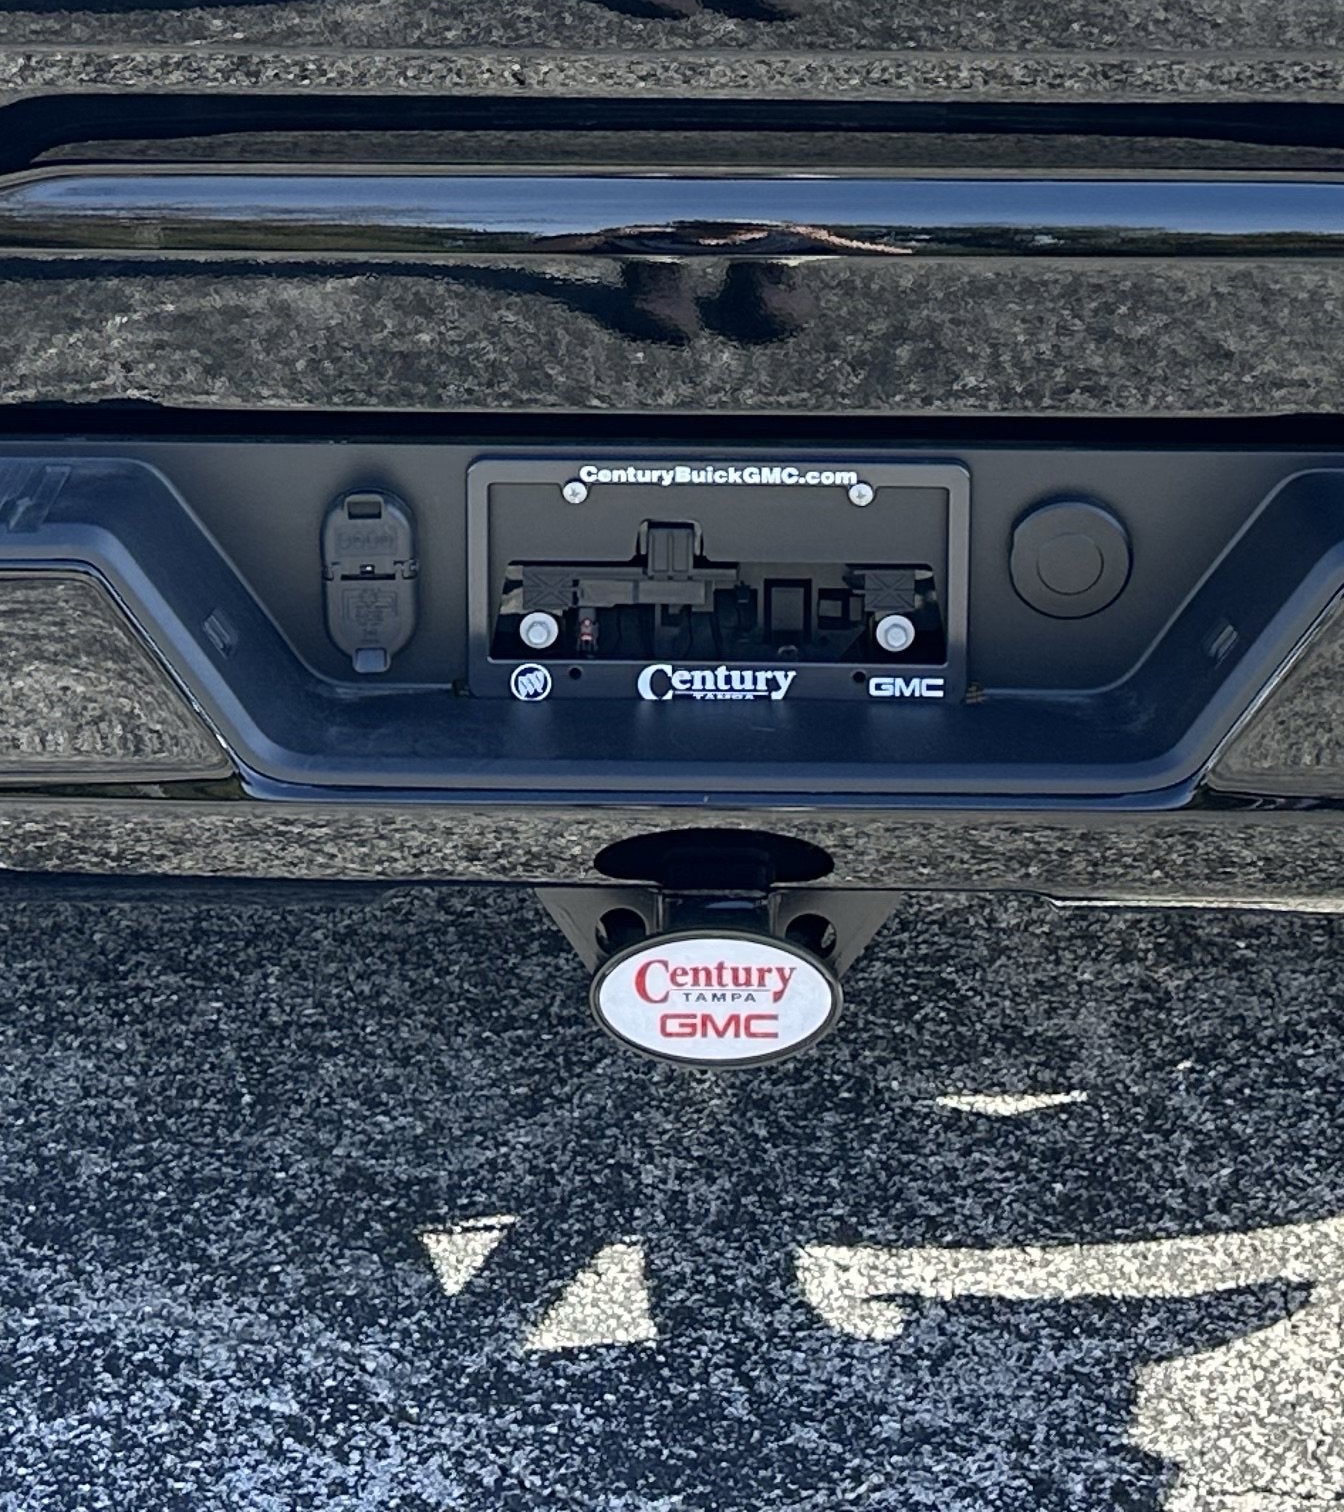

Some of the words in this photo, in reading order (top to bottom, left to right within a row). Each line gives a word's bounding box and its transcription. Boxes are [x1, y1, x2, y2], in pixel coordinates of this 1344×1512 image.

[579, 465, 858, 487] CenturyBuickGMC.com
[637, 664, 797, 700] Century
[868, 676, 944, 698] GMC
[634, 959, 797, 1004] Century
[682, 991, 757, 1003] TAMPA
[659, 1013, 779, 1038] GMC
